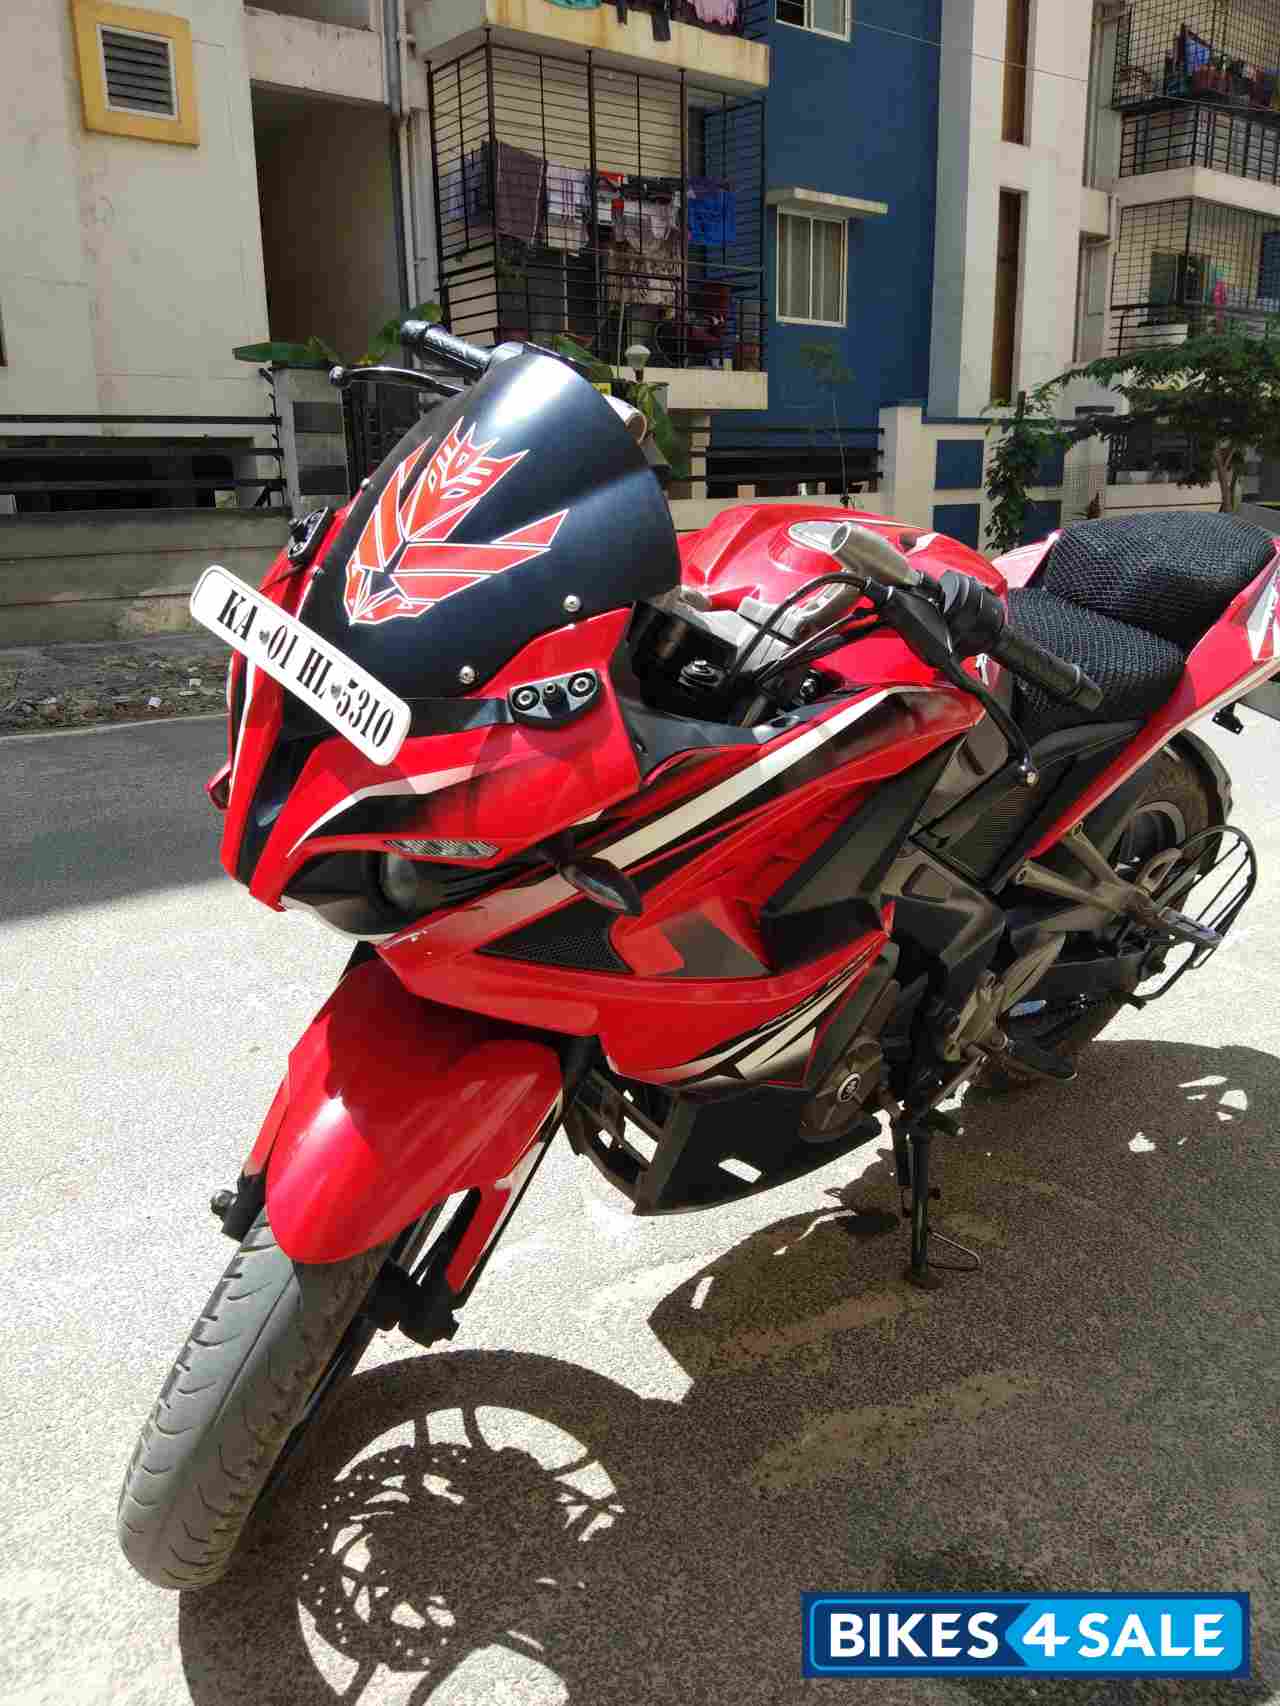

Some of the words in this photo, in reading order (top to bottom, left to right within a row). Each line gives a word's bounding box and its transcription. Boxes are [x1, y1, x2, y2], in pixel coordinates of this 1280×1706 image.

[217, 589, 258, 640] KA
[267, 624, 298, 669] 01
[296, 647, 332, 700] HL
[335, 679, 394, 748] 5310
